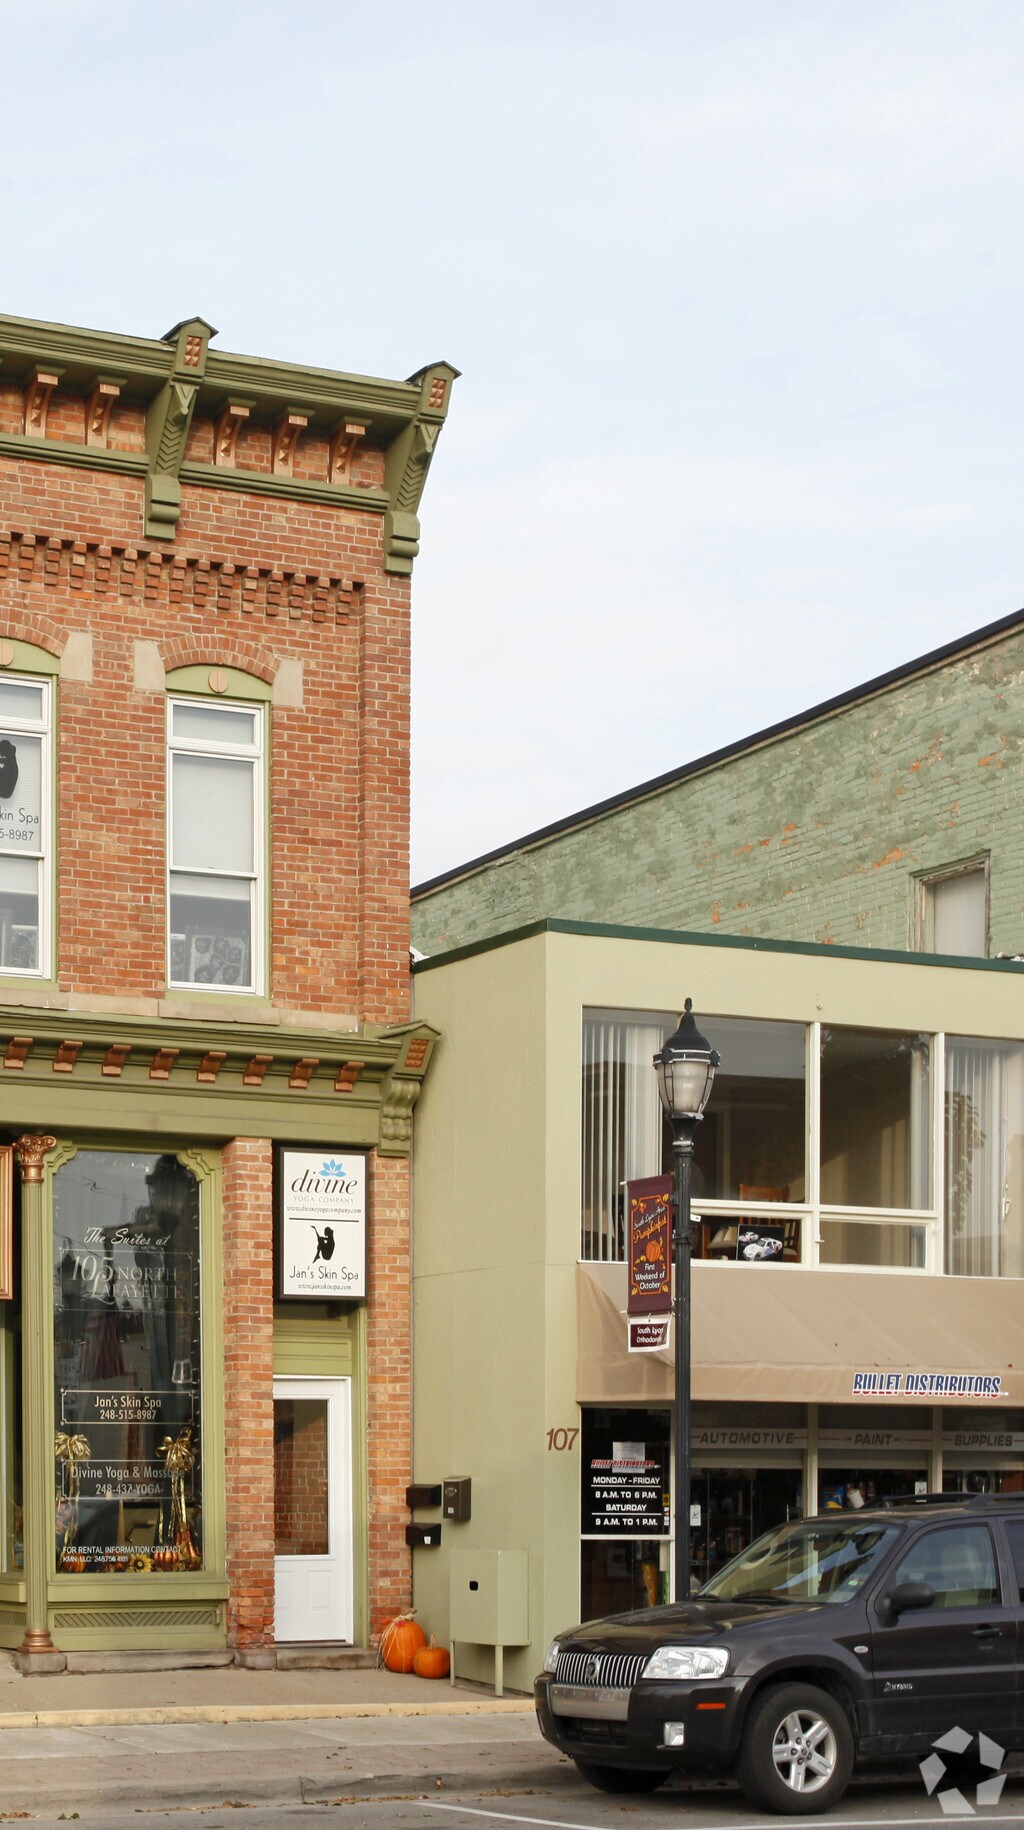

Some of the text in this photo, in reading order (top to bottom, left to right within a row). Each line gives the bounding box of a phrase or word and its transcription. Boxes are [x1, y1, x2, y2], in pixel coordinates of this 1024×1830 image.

[18, 807, 39, 825] Spa
[291, 1169, 358, 1195] divine
[294, 1195, 355, 1204] YOGA COMPANY
[84, 1227, 171, 1246] The Suites at
[72, 1254, 178, 1281] 105 NORTH
[644, 1263, 656, 1271] First
[289, 1265, 359, 1282] Jan's Skin Spa
[634, 1270, 665, 1281] Weekend of
[639, 1282, 661, 1290] October
[637, 1326, 651, 1334] South
[852, 1373, 1001, 1399] BULLET DISTRIBUTORS
[94, 1396, 162, 1410] Jan's Skin Spa
[99, 1409, 157, 1420] 248-515-8987
[546, 1428, 580, 1451] 107
[699, 1432, 794, 1445] AUTOMOTIVE
[854, 1434, 893, 1446] PAINT
[953, 1435, 1013, 1447] SUPPLIES
[71, 1466, 185, 1481] Divine Yoga & Massae
[95, 1483, 161, 1495] 248-437-YOGA
[602, 1491, 619, 1499] A.M.
[621, 1491, 632, 1499] TO
[642, 1491, 657, 1499] P.M.
[603, 1518, 620, 1526] A.M.
[622, 1518, 634, 1526] TO
[642, 1518, 658, 1526] P.M.
[62, 1546, 77, 1554] FOR
[78, 1546, 104, 1554] RENTAL
[105, 1546, 150, 1554] INFORMATION
